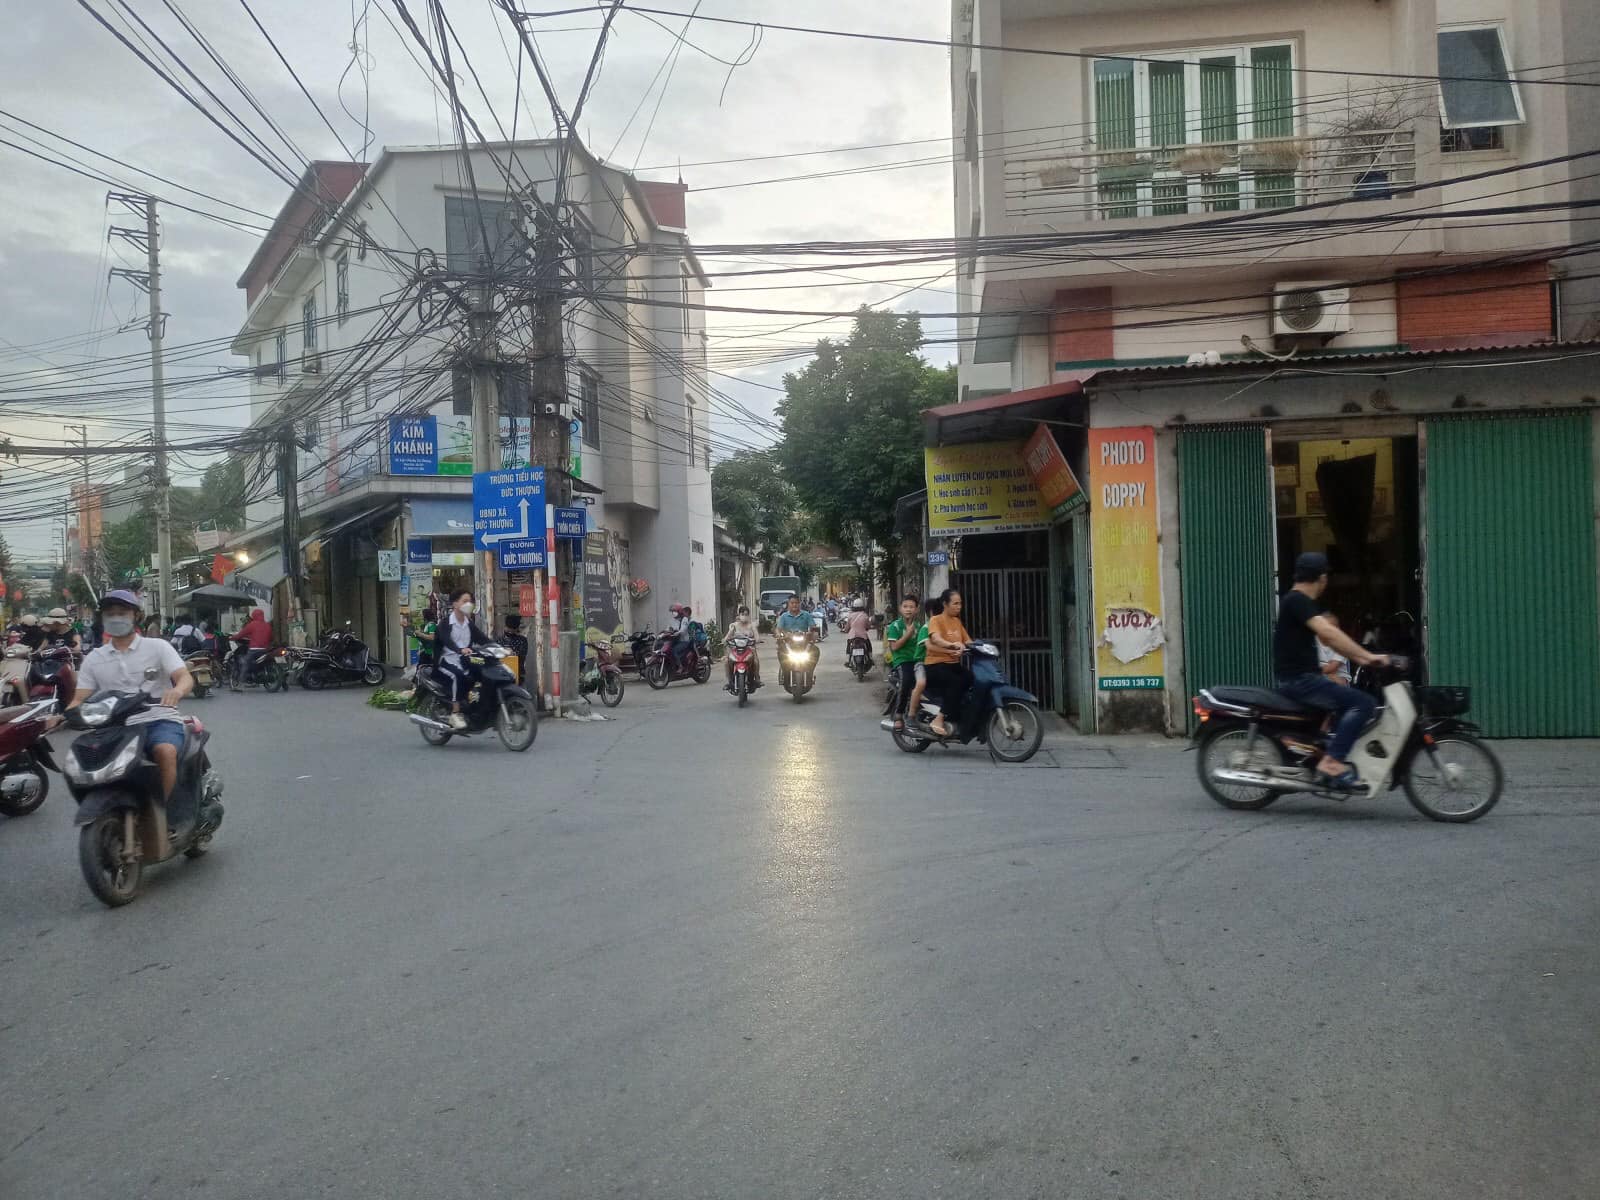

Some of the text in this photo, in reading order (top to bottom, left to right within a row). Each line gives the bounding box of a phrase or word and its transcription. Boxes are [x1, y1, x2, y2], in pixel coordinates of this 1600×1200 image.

[402, 425, 424, 438] KIM
[393, 440, 433, 455] KHÁNH
[1101, 439, 1145, 465] PHOTO
[530, 471, 544, 482] HỌC
[515, 485, 540, 496] THƯỢNG
[1103, 481, 1146, 508] COPPY
[479, 508, 497, 518] UBND
[489, 518, 514, 530] THƯỢNG
[518, 551, 543, 566] THƯỢNG
[929, 553, 945, 563] 236
[1147, 678, 1159, 686] 737
